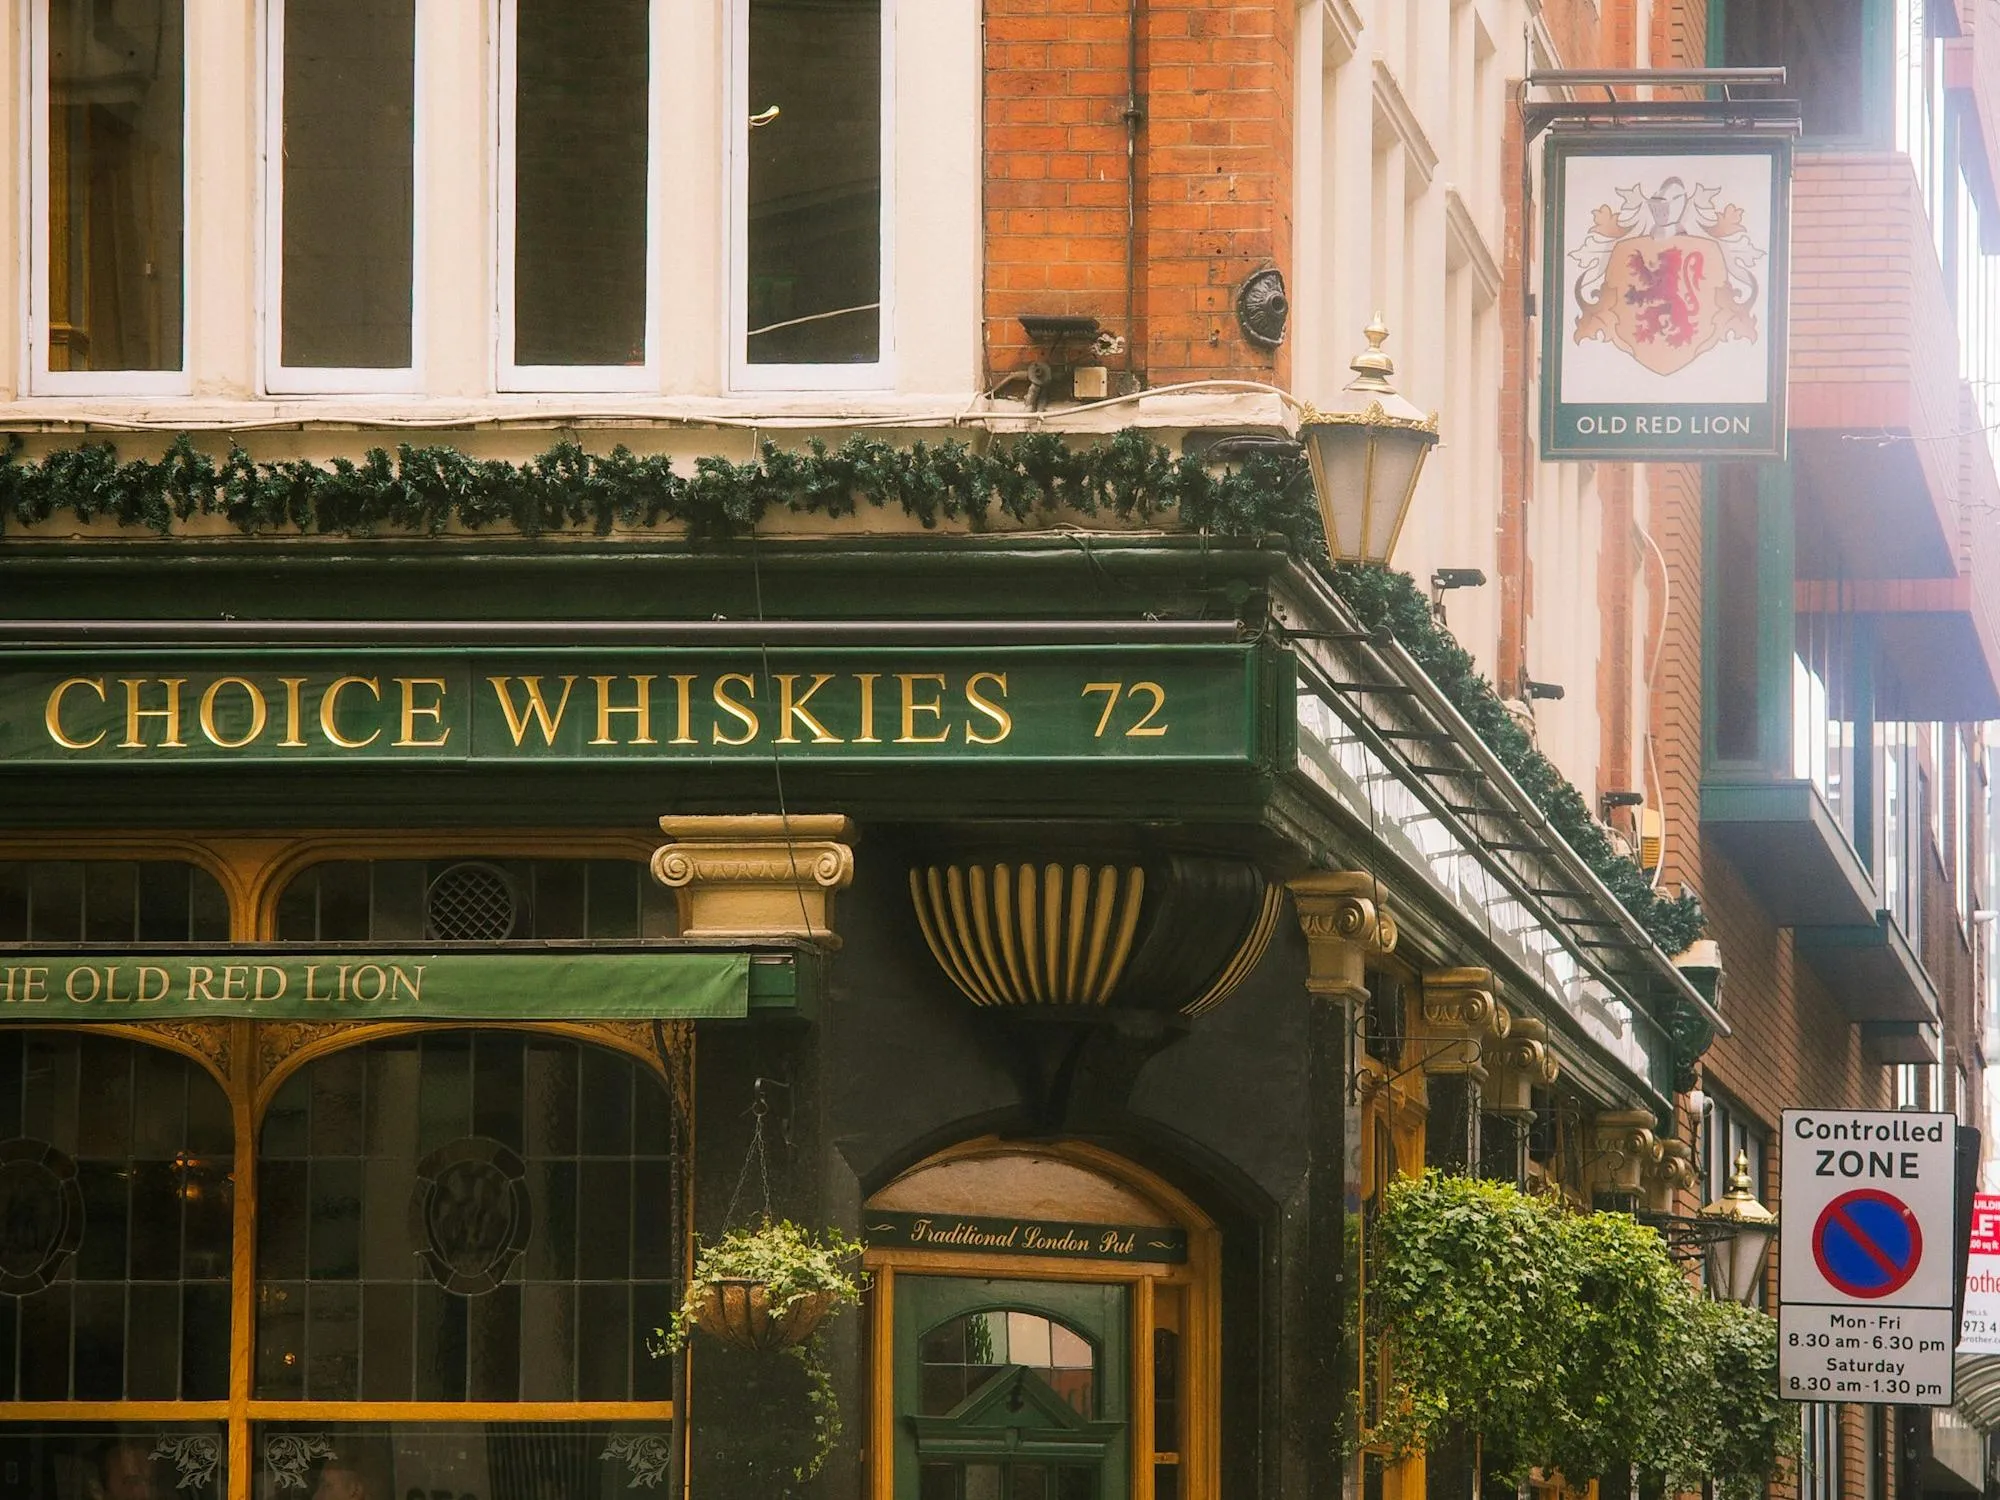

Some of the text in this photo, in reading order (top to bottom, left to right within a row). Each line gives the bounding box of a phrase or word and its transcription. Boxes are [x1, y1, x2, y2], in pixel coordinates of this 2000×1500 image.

[1576, 415, 1751, 435] OLD RED LION
[45, 672, 1012, 750] CHOICE WHISKIES
[1081, 681, 1169, 738] 72
[65, 966, 171, 1003] OLD
[184, 965, 288, 1002] RED
[303, 964, 427, 1001] LION
[1795, 1117, 1943, 1143] Controlled
[1816, 1150, 1920, 1179] ZONE
[910, 1218, 1136, 1254] Traditional London Pub
[1788, 1333, 1830, 1348] 8.30
[1919, 1339, 1945, 1353] pm
[1826, 1357, 1905, 1375] Saturday
[1789, 1377, 1831, 1391] 8.30
[1916, 1383, 1942, 1397] pm
